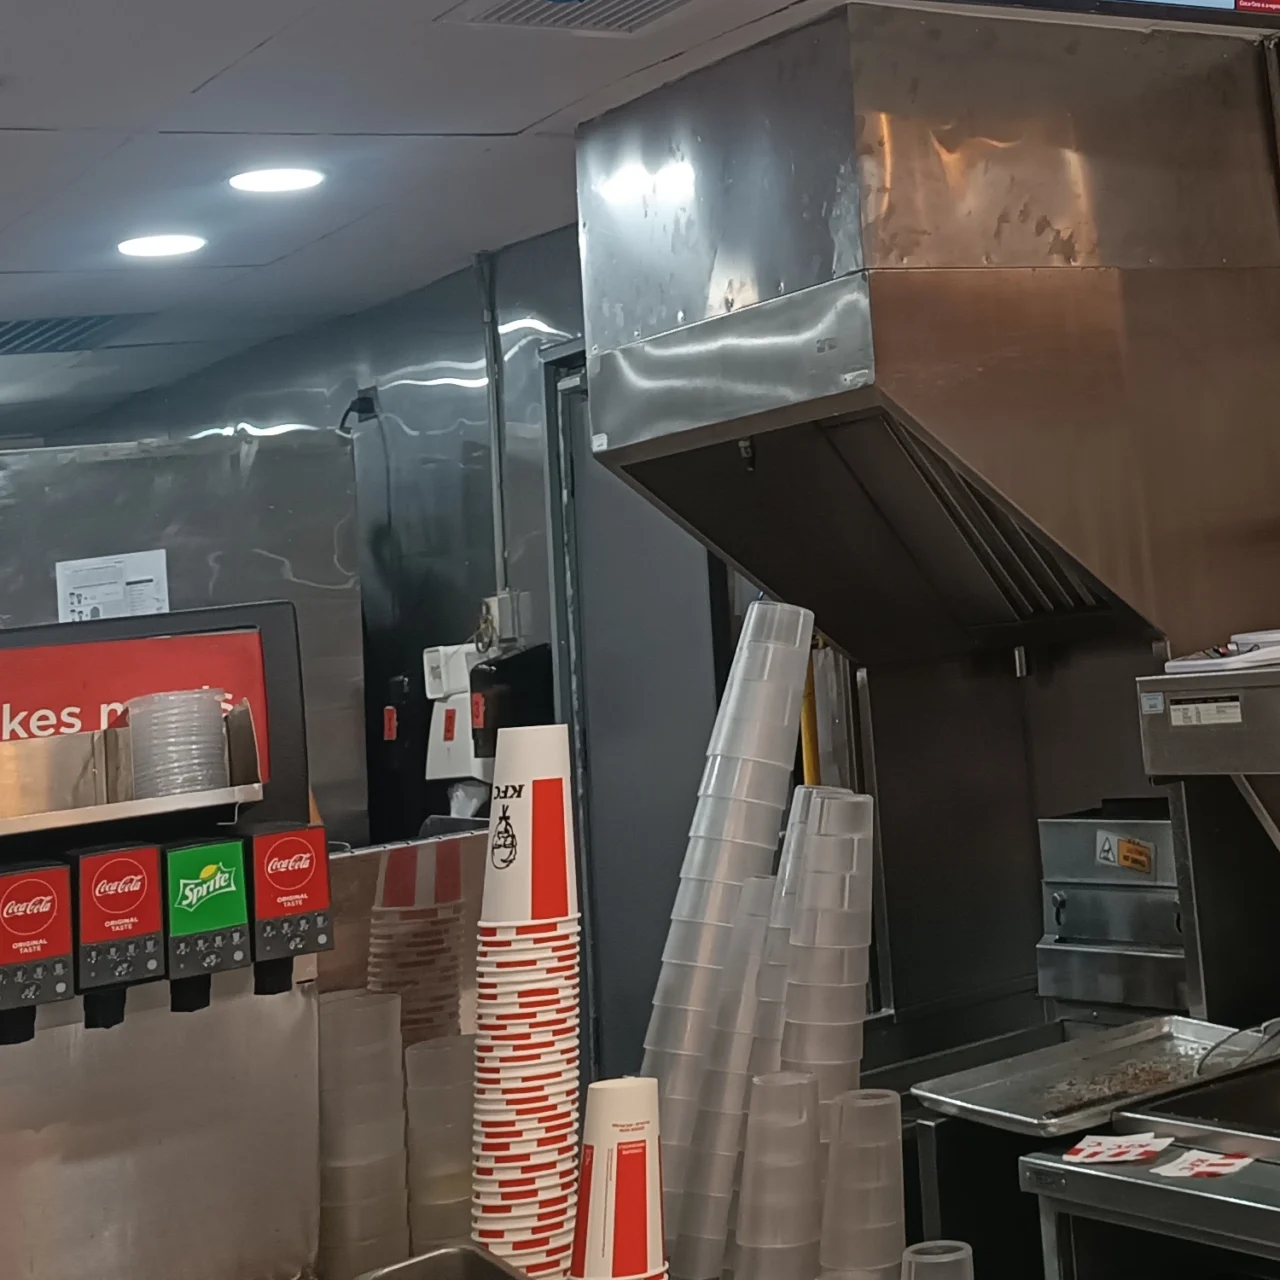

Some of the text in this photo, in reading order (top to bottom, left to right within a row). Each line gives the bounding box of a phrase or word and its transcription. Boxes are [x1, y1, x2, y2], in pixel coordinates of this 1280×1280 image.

[2, 704, 82, 740] kes
[493, 784, 525, 800] KFC
[268, 853, 313, 874] Coca-Cola
[95, 875, 143, 897] Coca-Cola
[182, 871, 229, 906] Sprite
[276, 893, 308, 903] ORIGINAL
[3, 896, 53, 918] Coca-Cola
[105, 917, 138, 927] ORIGINAL
[111, 924, 132, 932] TASTE
[12, 938, 48, 949] ORIGINAL
[19, 946, 41, 954] TASTE
